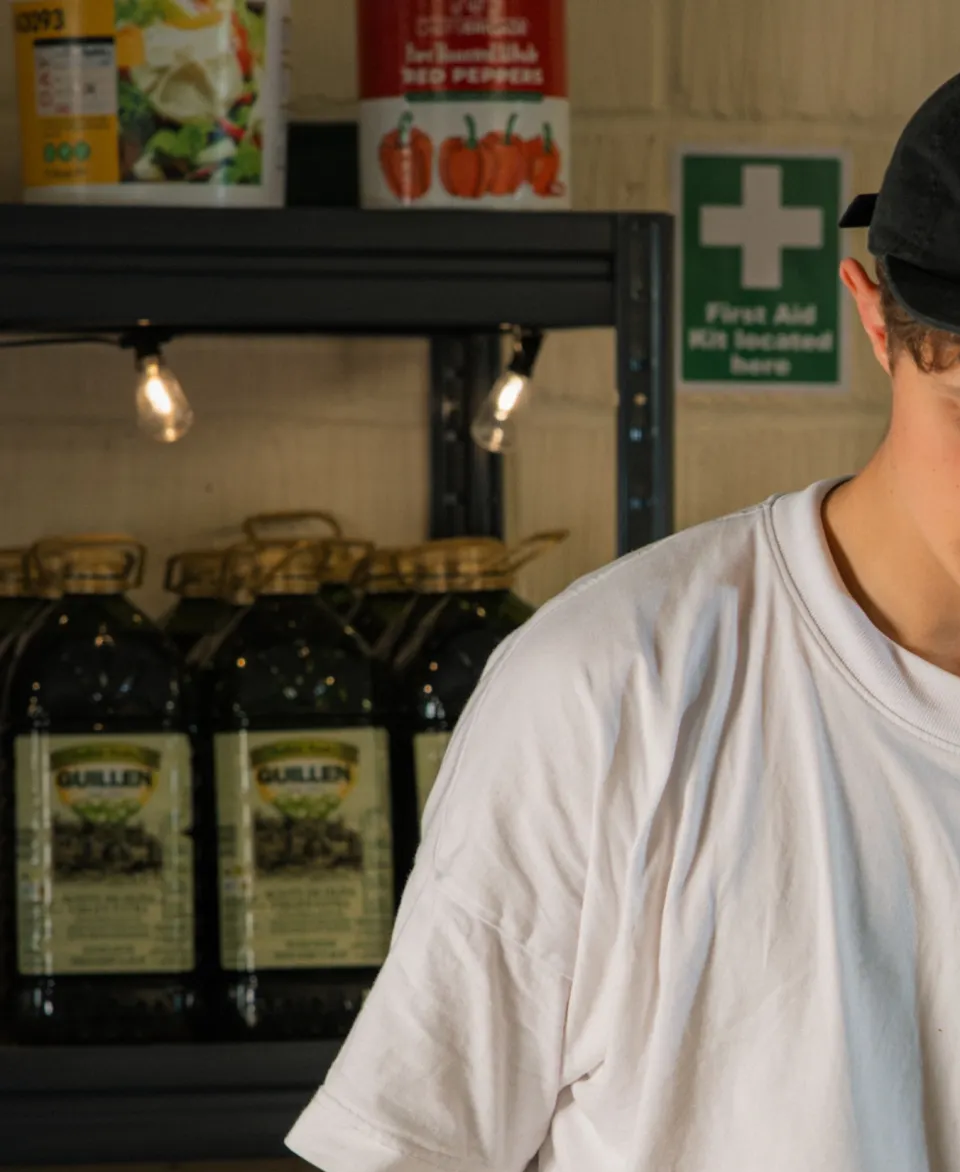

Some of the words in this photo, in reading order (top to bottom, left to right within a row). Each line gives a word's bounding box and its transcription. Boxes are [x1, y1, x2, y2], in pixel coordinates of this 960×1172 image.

[402, 67, 446, 85] RED
[451, 67, 544, 85] PEPPERS
[704, 302, 766, 325] First
[773, 303, 817, 325] Aid
[688, 328, 728, 349] Kit
[734, 329, 833, 351] located
[730, 354, 791, 376] here
